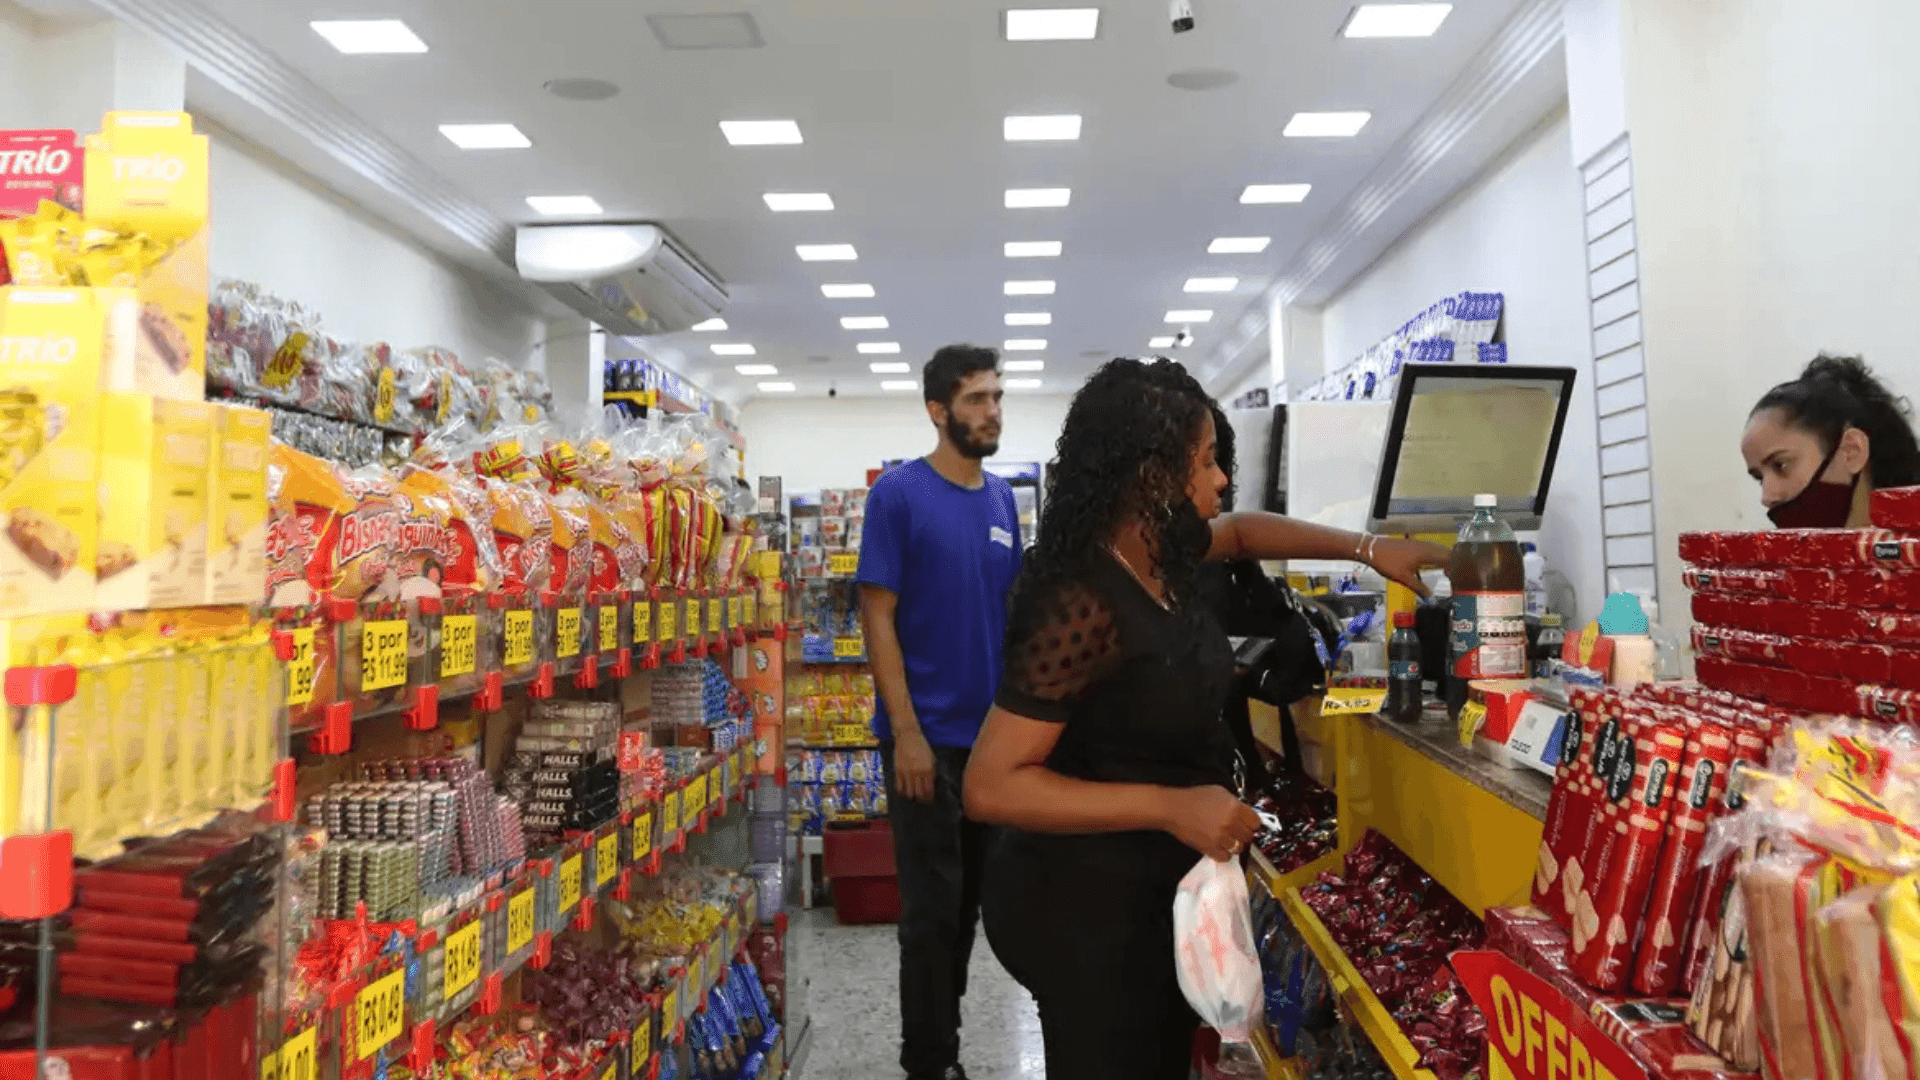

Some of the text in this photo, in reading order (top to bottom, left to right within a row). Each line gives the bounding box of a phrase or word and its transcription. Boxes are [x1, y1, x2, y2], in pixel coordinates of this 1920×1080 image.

[443, 623, 472, 645] 3 por
[507, 618, 530, 636] 3 por
[364, 631, 403, 655] 3 por
[362, 656, 375, 683] R$
[544, 755, 579, 766] HALLS
[532, 771, 569, 783] HALLS
[536, 787, 573, 799] HALLS
[528, 802, 566, 813] HALLS
[522, 815, 561, 826] HALLS
[1490, 975, 1619, 1080] OFER
